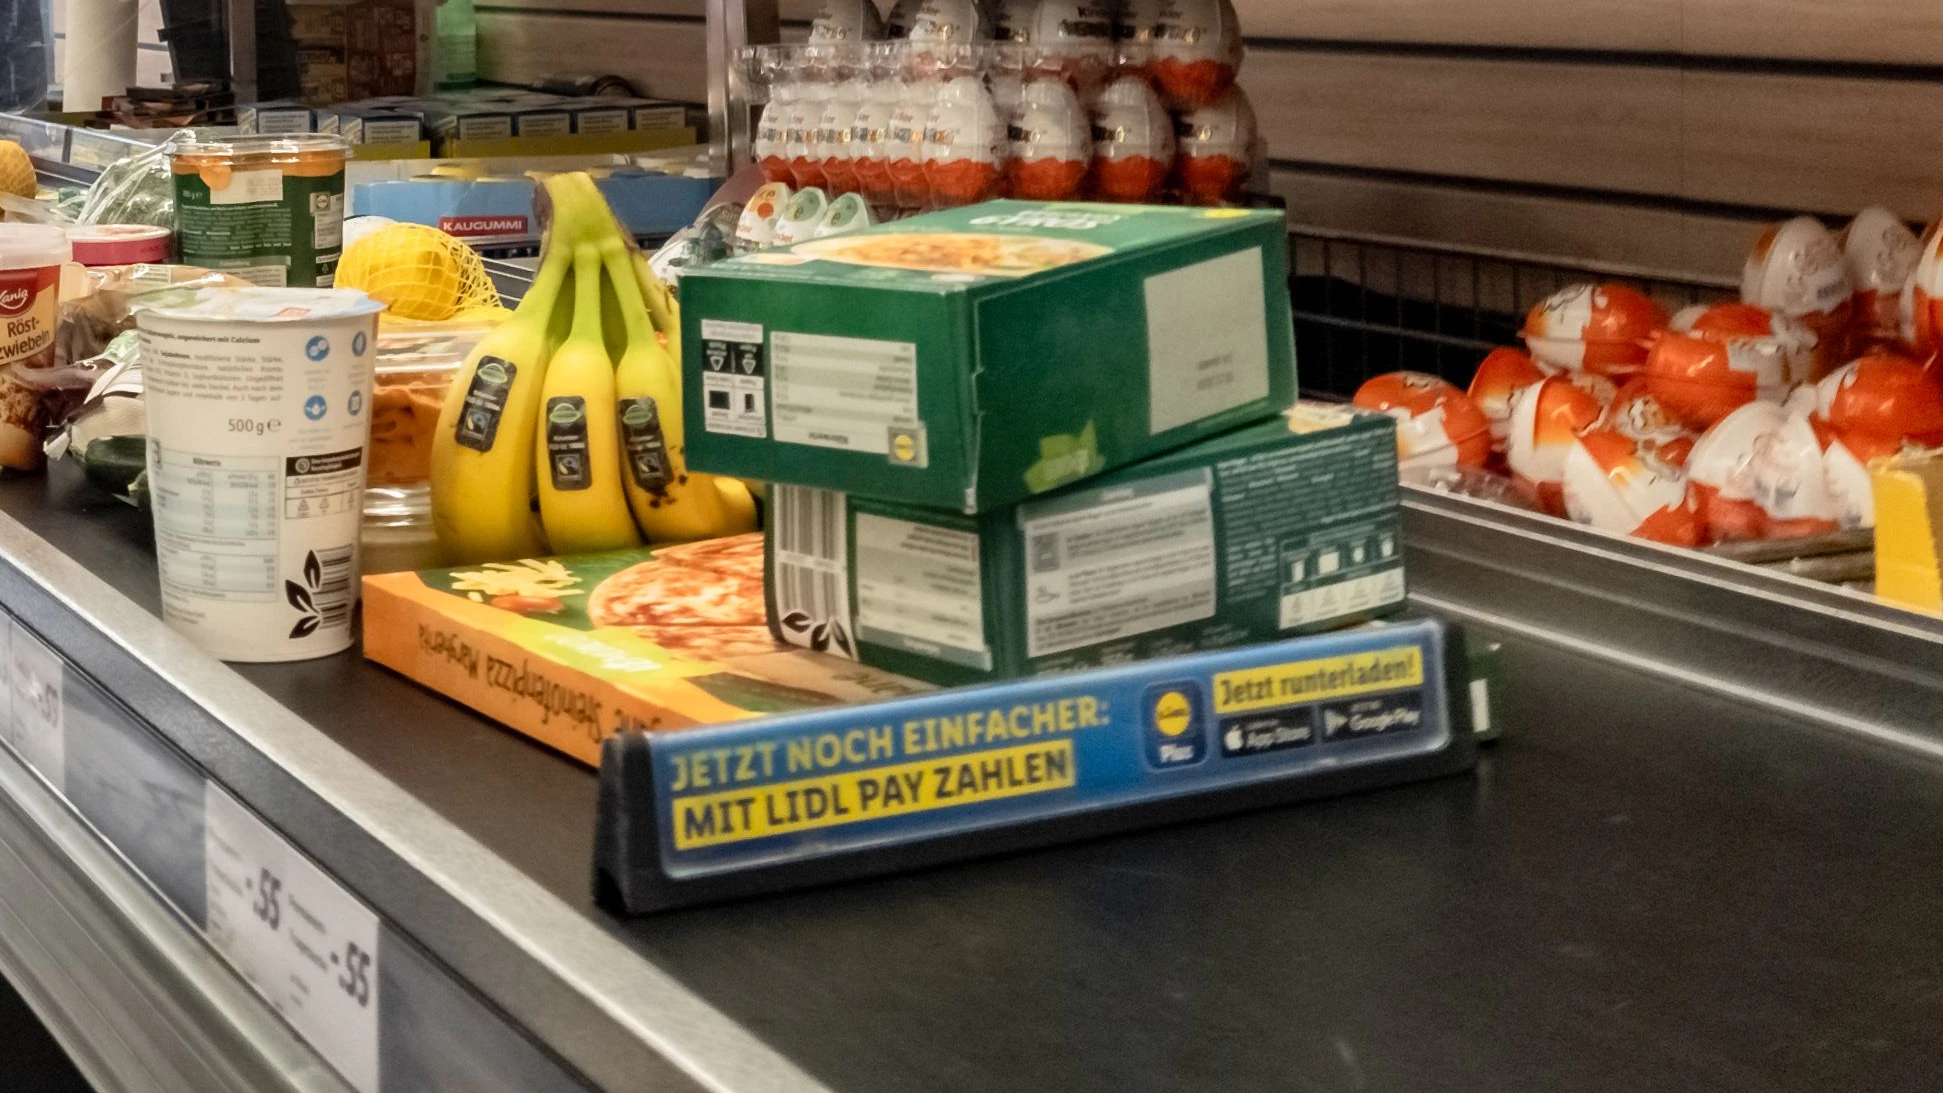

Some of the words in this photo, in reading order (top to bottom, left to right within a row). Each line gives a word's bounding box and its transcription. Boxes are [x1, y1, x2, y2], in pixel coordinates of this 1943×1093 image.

[443, 220, 522, 231] KAUGUMMI
[7, 316, 40, 338] Röst-
[228, 419, 254, 432] 500
[256, 422, 264, 436] g
[1222, 675, 1273, 706] Jetzt
[1280, 653, 1415, 696] runterladen!
[671, 742, 777, 791] JETZT
[787, 724, 893, 773] NOCH
[904, 696, 1109, 756] EINFACHER:
[684, 797, 755, 838] MIT
[766, 784, 849, 826] LIDL
[857, 770, 924, 811] PAY
[933, 749, 1067, 799] ZAHLEN
